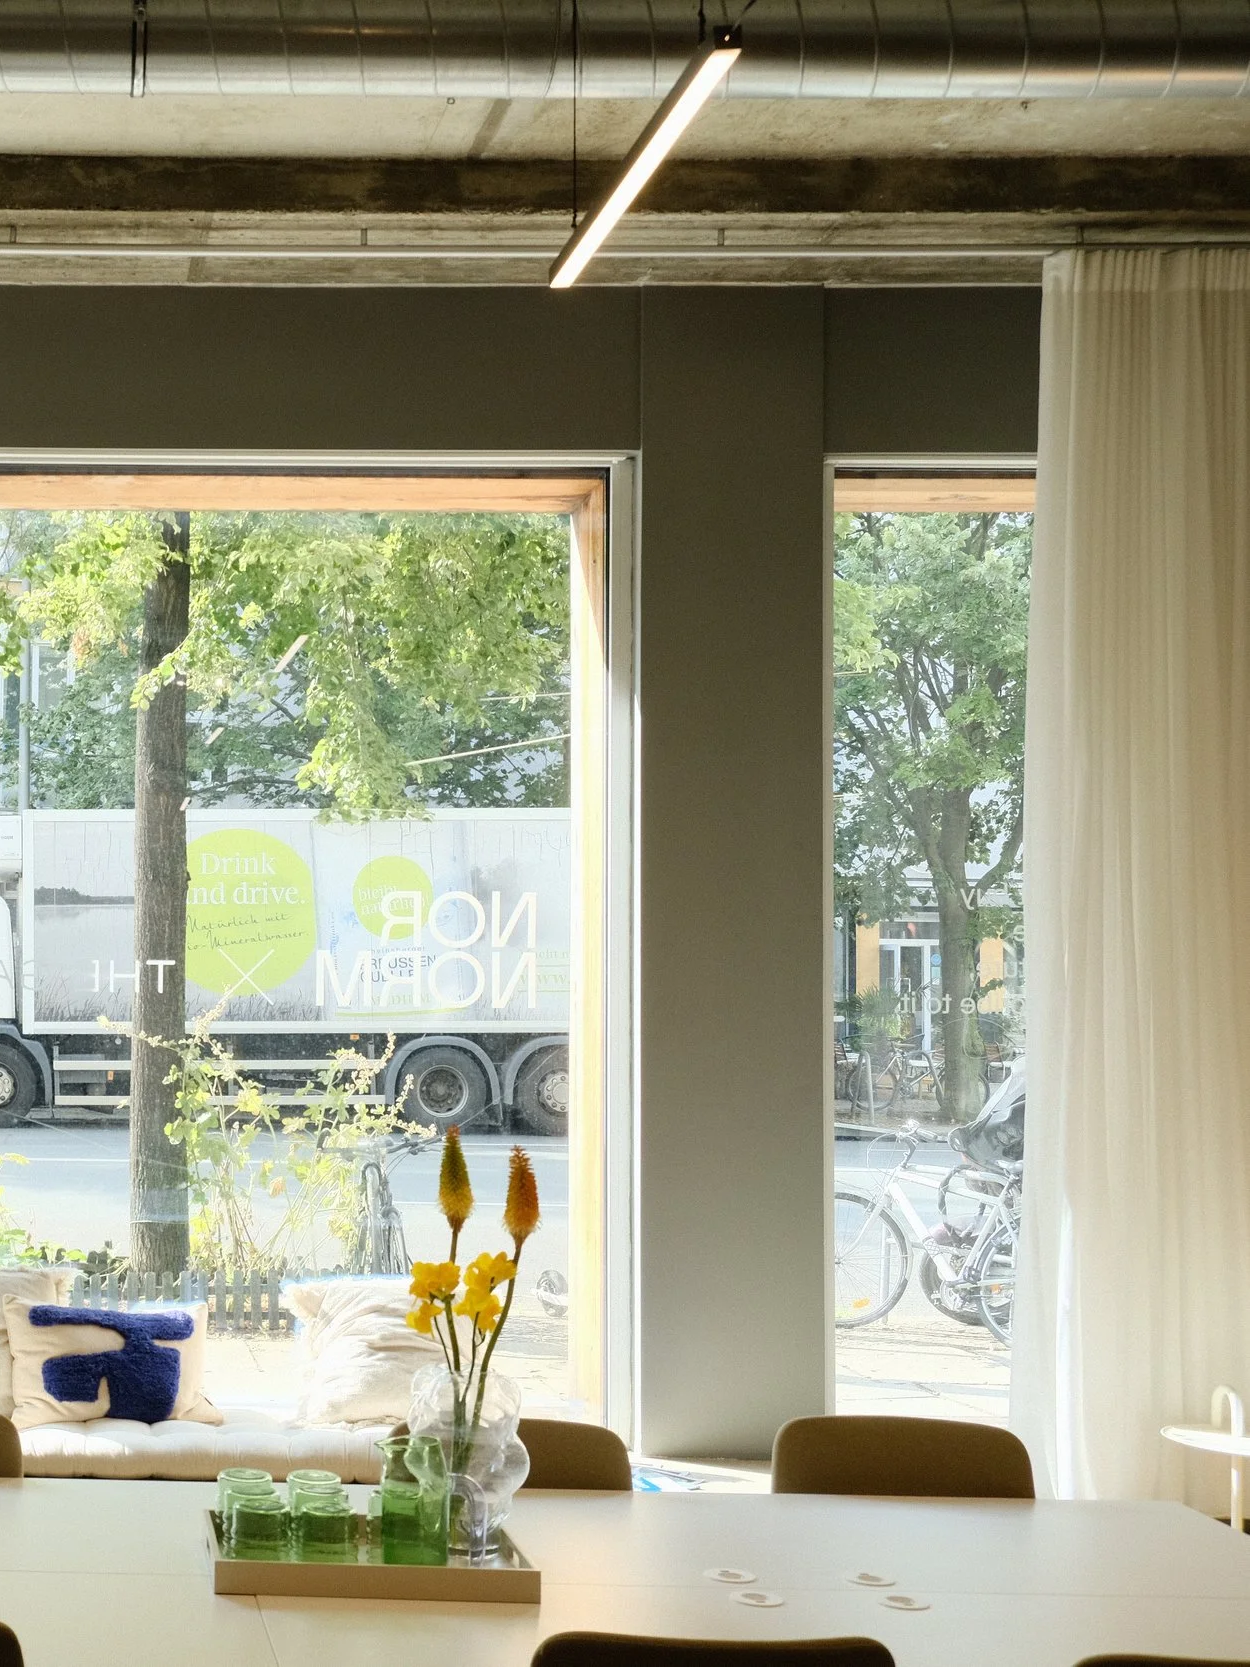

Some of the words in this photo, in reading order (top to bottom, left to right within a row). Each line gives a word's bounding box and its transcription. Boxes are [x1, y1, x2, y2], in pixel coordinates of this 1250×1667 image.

[199, 851, 277, 875] Drink
[186, 881, 227, 905] nd
[232, 881, 306, 905] drive.
[186, 930, 309, 951] io-Mineralwasser.
